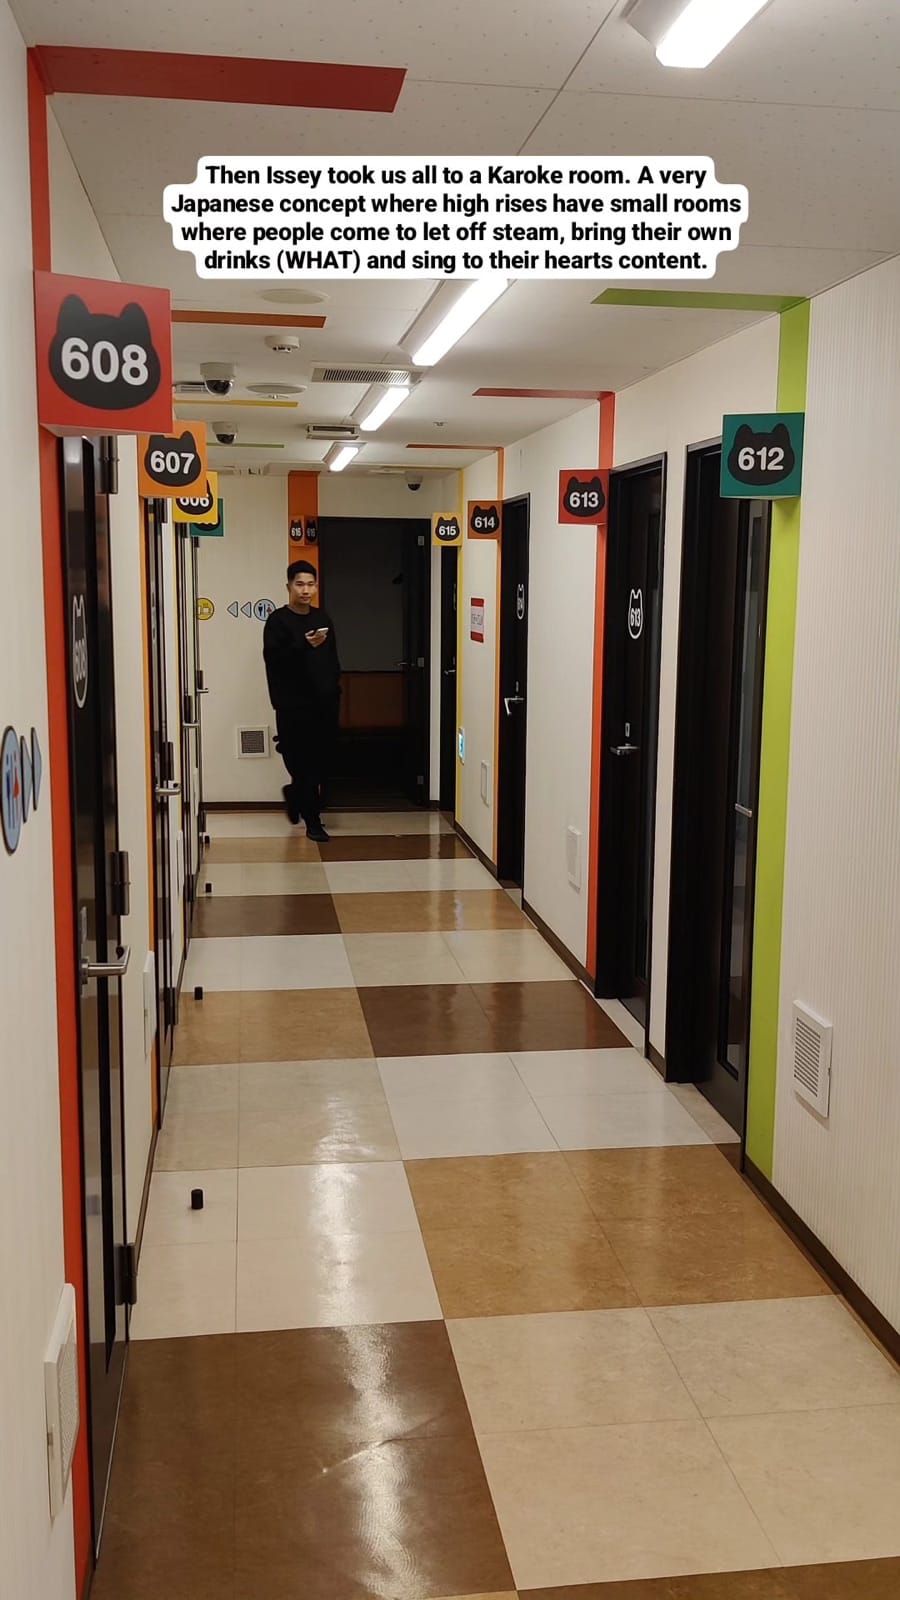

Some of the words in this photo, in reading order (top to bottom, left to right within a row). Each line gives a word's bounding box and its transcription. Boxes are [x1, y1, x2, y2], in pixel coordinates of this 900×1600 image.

[61, 337, 149, 386] 608
[150, 450, 195, 475] 607
[738, 446, 785, 471] 612
[569, 491, 599, 508] 613
[438, 525, 457, 536] 615
[474, 516, 496, 529] 614
[630, 607, 641, 628] 613
